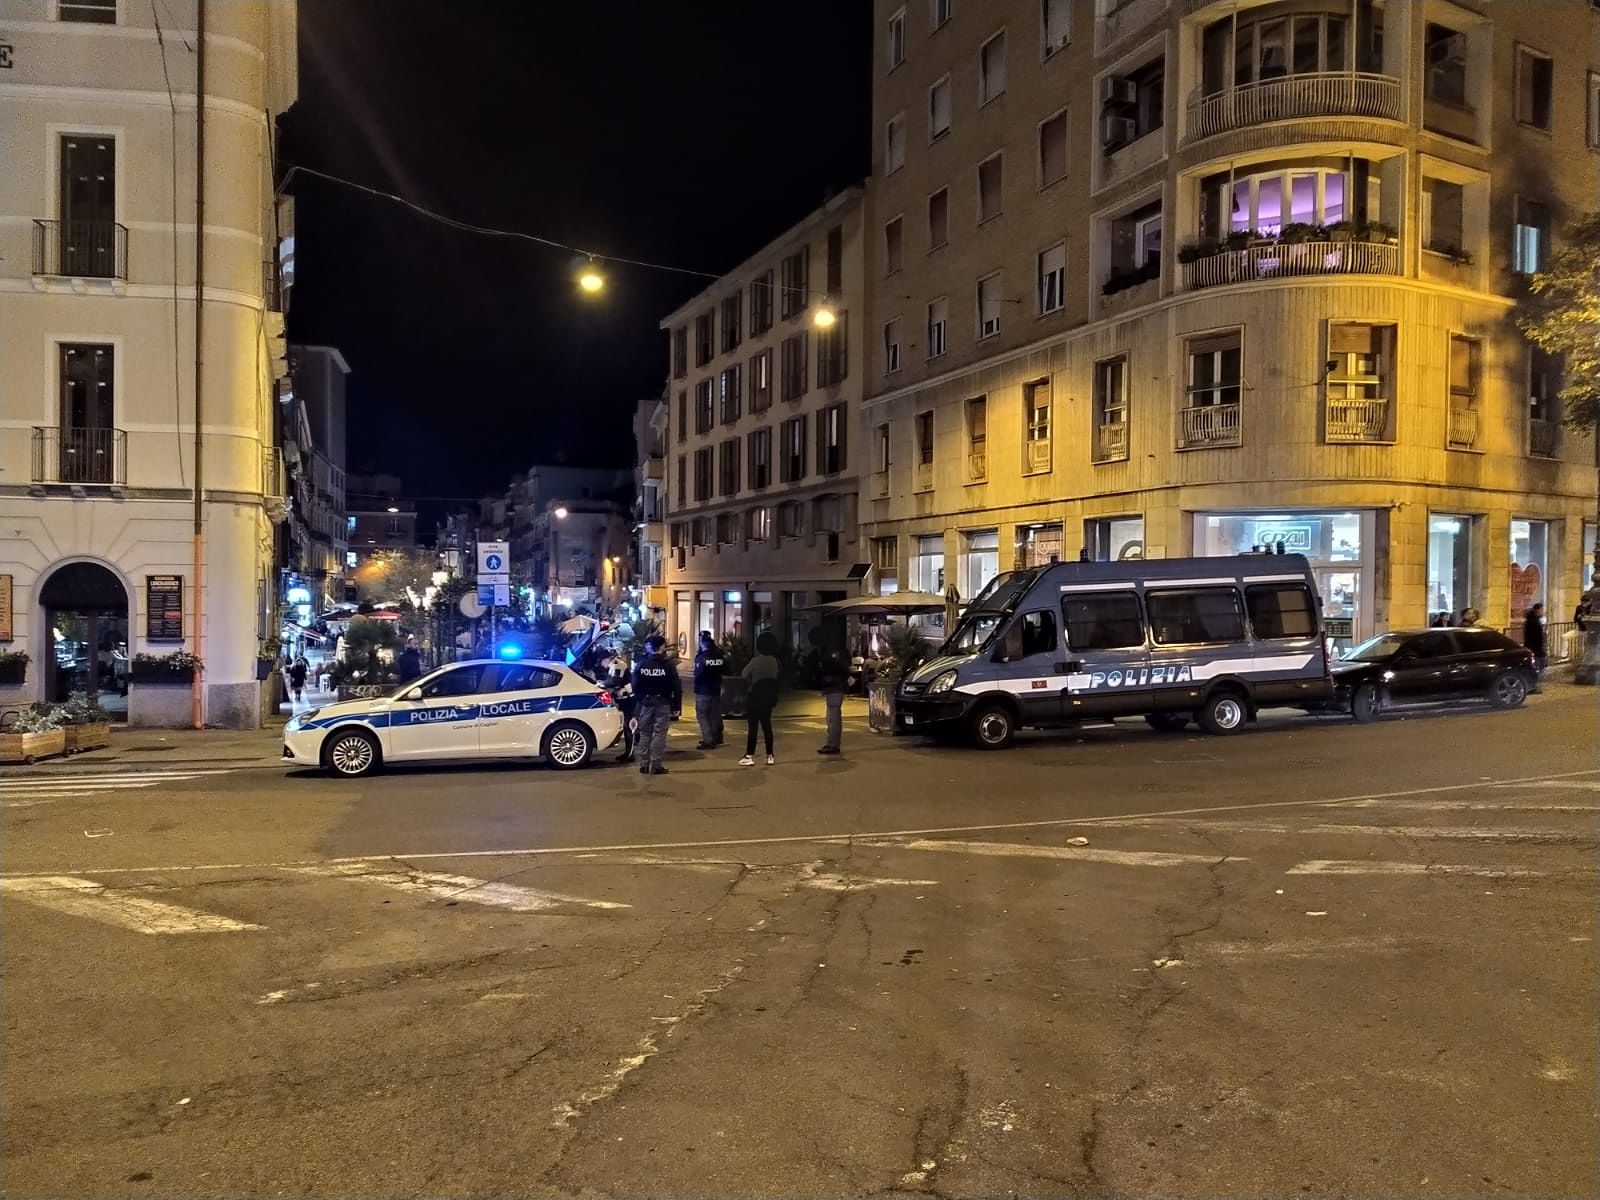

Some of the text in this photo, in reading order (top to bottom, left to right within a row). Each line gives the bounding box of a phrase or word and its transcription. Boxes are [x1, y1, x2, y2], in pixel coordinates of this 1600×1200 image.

[705, 659, 724, 667] POLIZI
[640, 668, 666, 677] POLIZIA
[1091, 665, 1192, 689] POLIZIA
[410, 702, 531, 721] POLIZIA LOCALE
